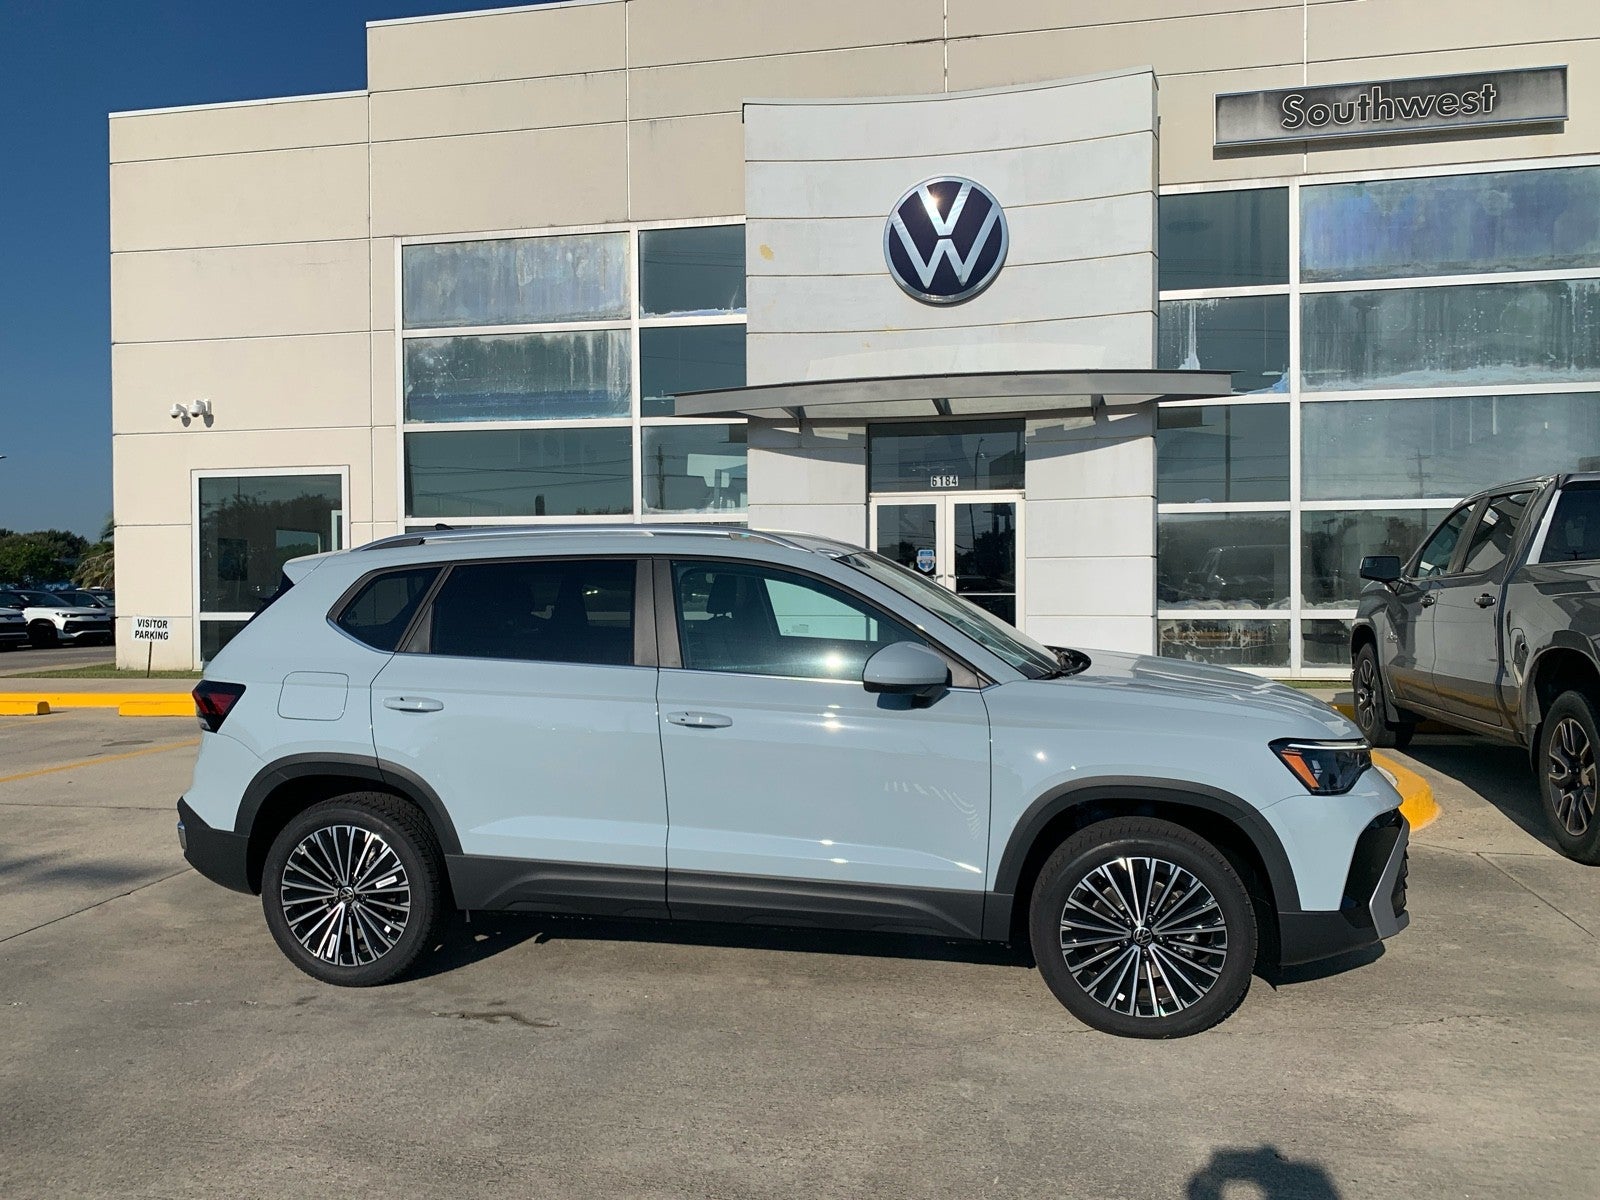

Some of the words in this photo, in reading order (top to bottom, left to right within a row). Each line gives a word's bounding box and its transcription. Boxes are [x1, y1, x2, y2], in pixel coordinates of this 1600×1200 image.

[1281, 84, 1497, 129] Southwest
[888, 180, 1003, 291] VW
[931, 475, 957, 487] 6184
[137, 618, 168, 629] VISITOR
[134, 630, 169, 640] PARKING
